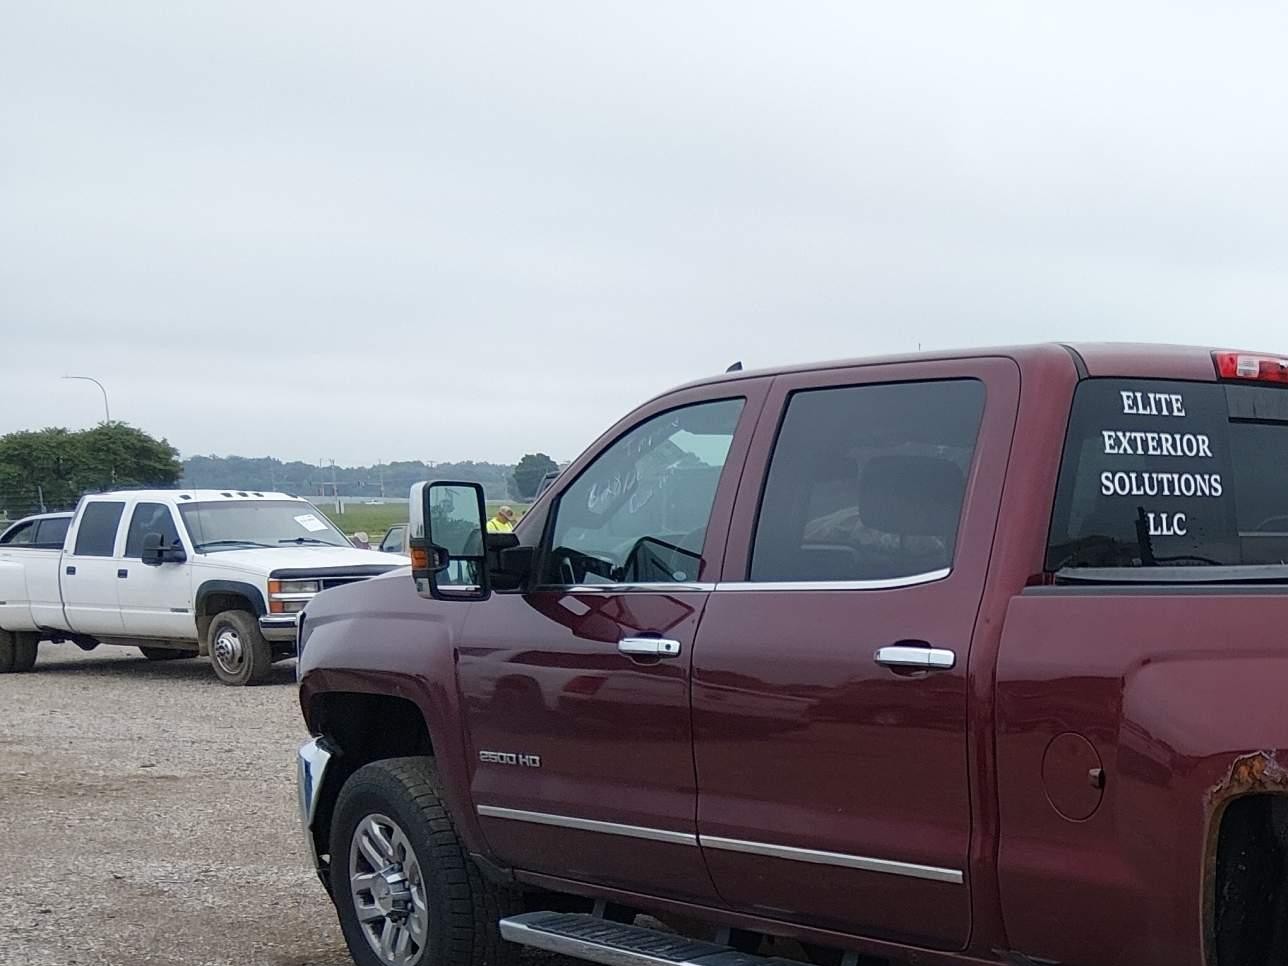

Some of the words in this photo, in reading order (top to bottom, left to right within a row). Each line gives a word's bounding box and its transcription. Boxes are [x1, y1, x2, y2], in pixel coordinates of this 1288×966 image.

[1120, 390, 1186, 417] ELITE
[1102, 430, 1213, 457] EXTERIOR
[1101, 471, 1223, 497] SOLUTIONS
[1147, 512, 1187, 536] LLC
[479, 750, 517, 765] 2500
[518, 754, 541, 768] HD
